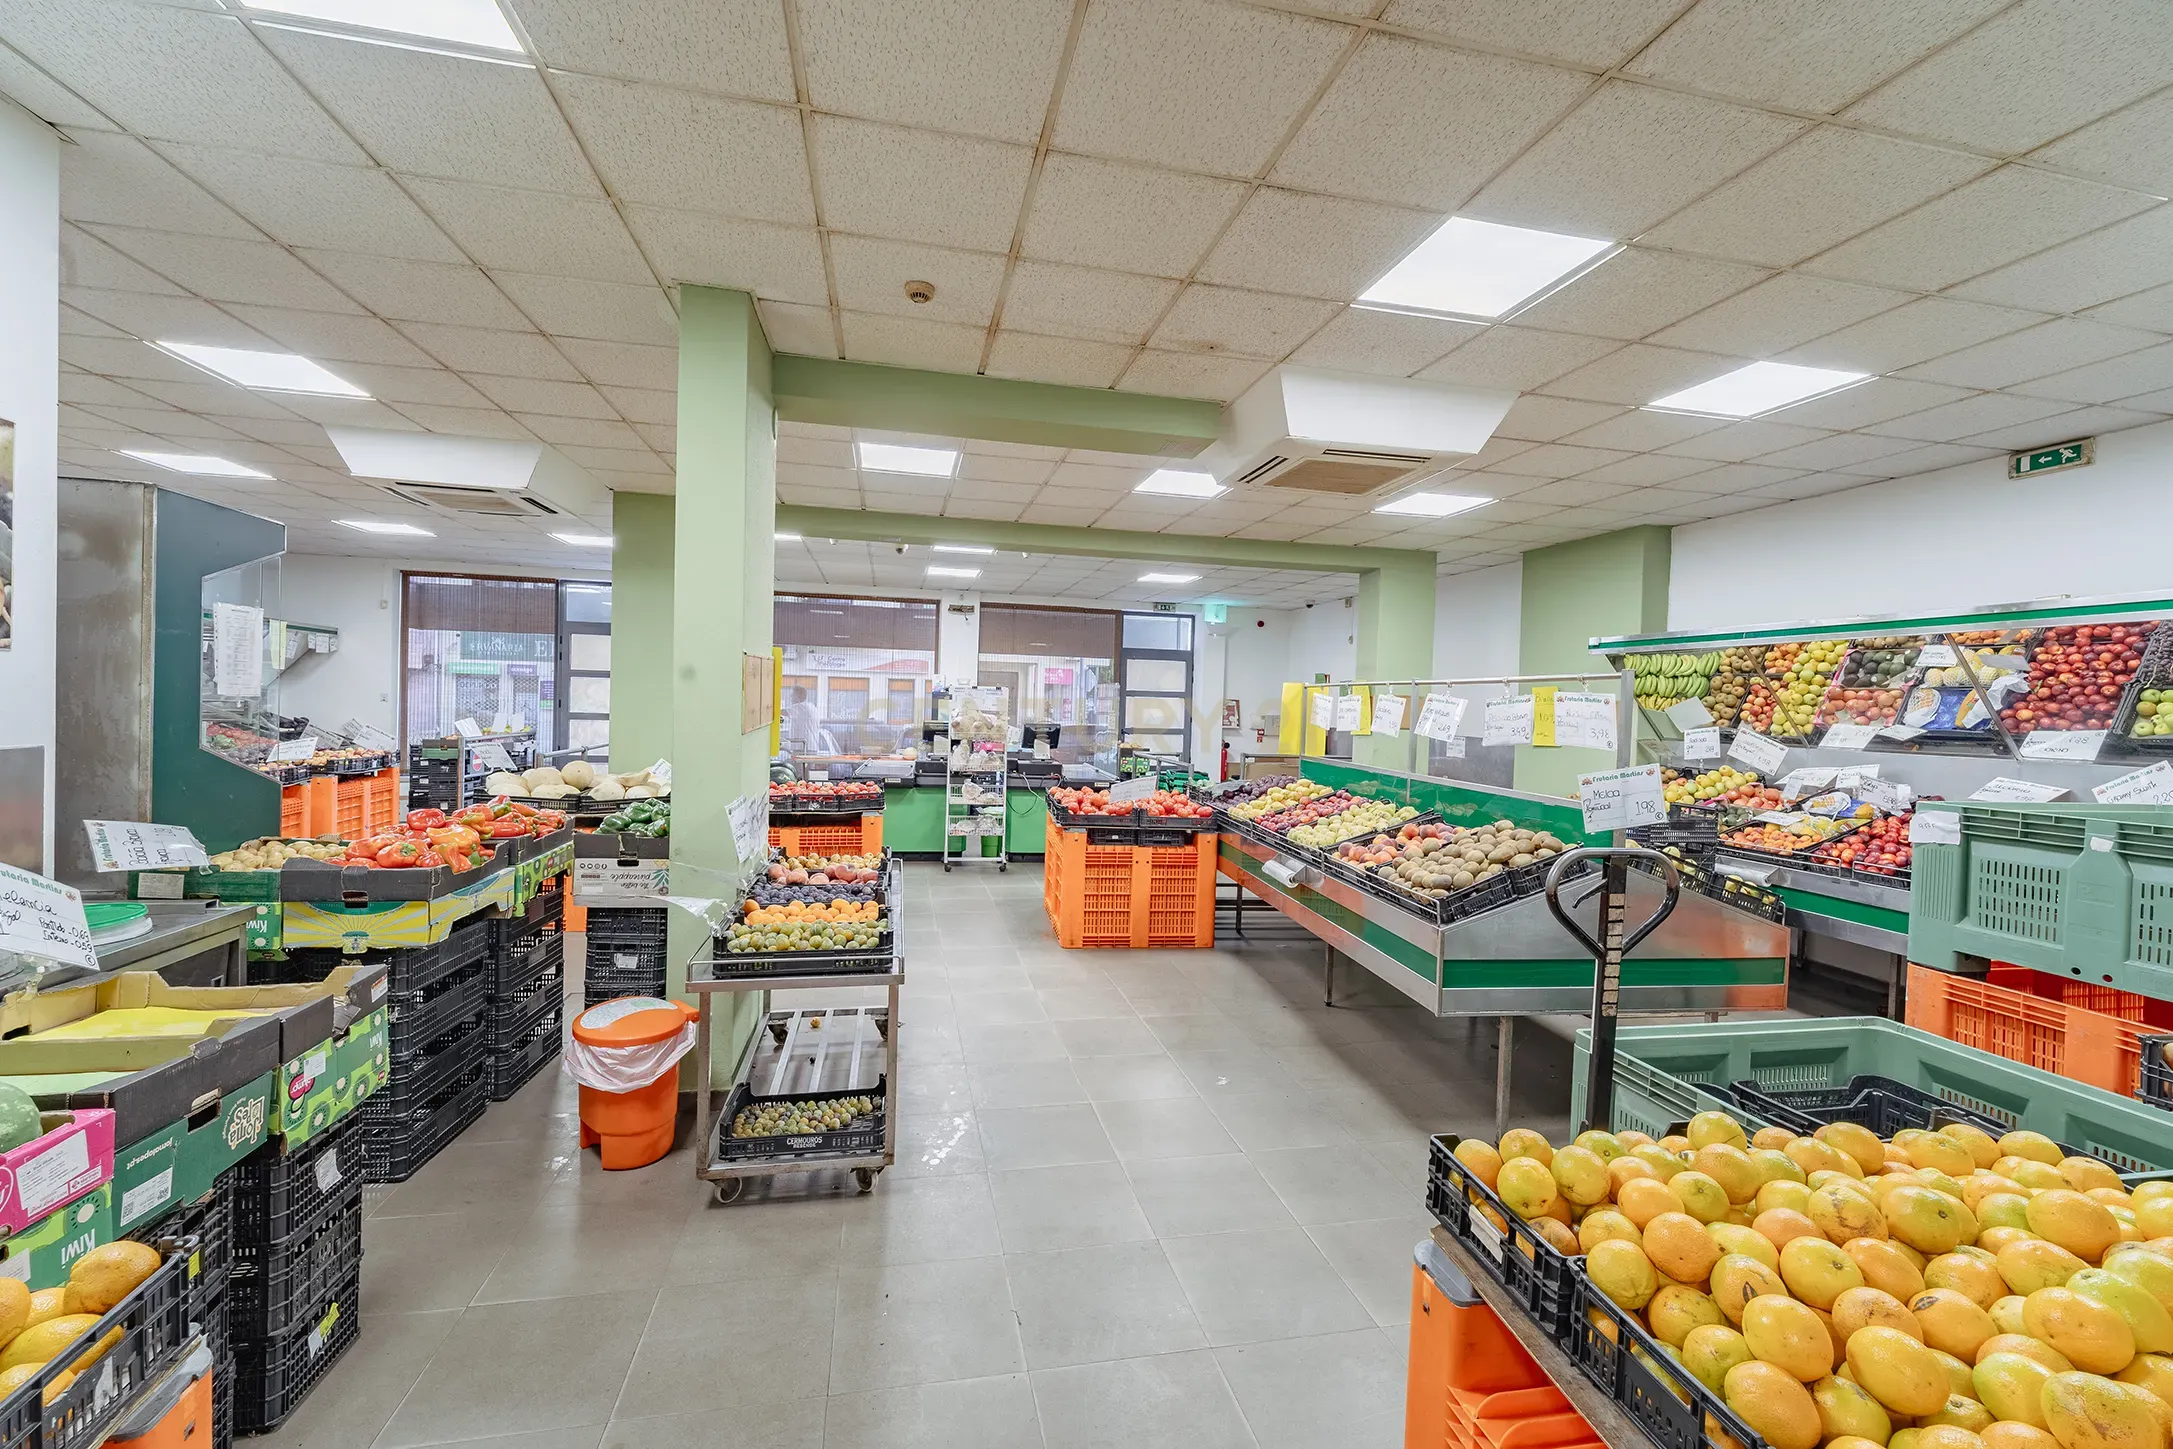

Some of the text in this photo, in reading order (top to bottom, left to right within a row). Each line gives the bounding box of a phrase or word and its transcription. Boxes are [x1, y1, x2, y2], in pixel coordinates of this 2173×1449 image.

[1593, 771, 1644, 783] Frutaria Martins
[0, 869, 62, 894] utaria Martins
[0, 890, 57, 916] elancia
[786, 1136, 823, 1145] CERMOUROS
[61, 1228, 96, 1269] Kiwi
